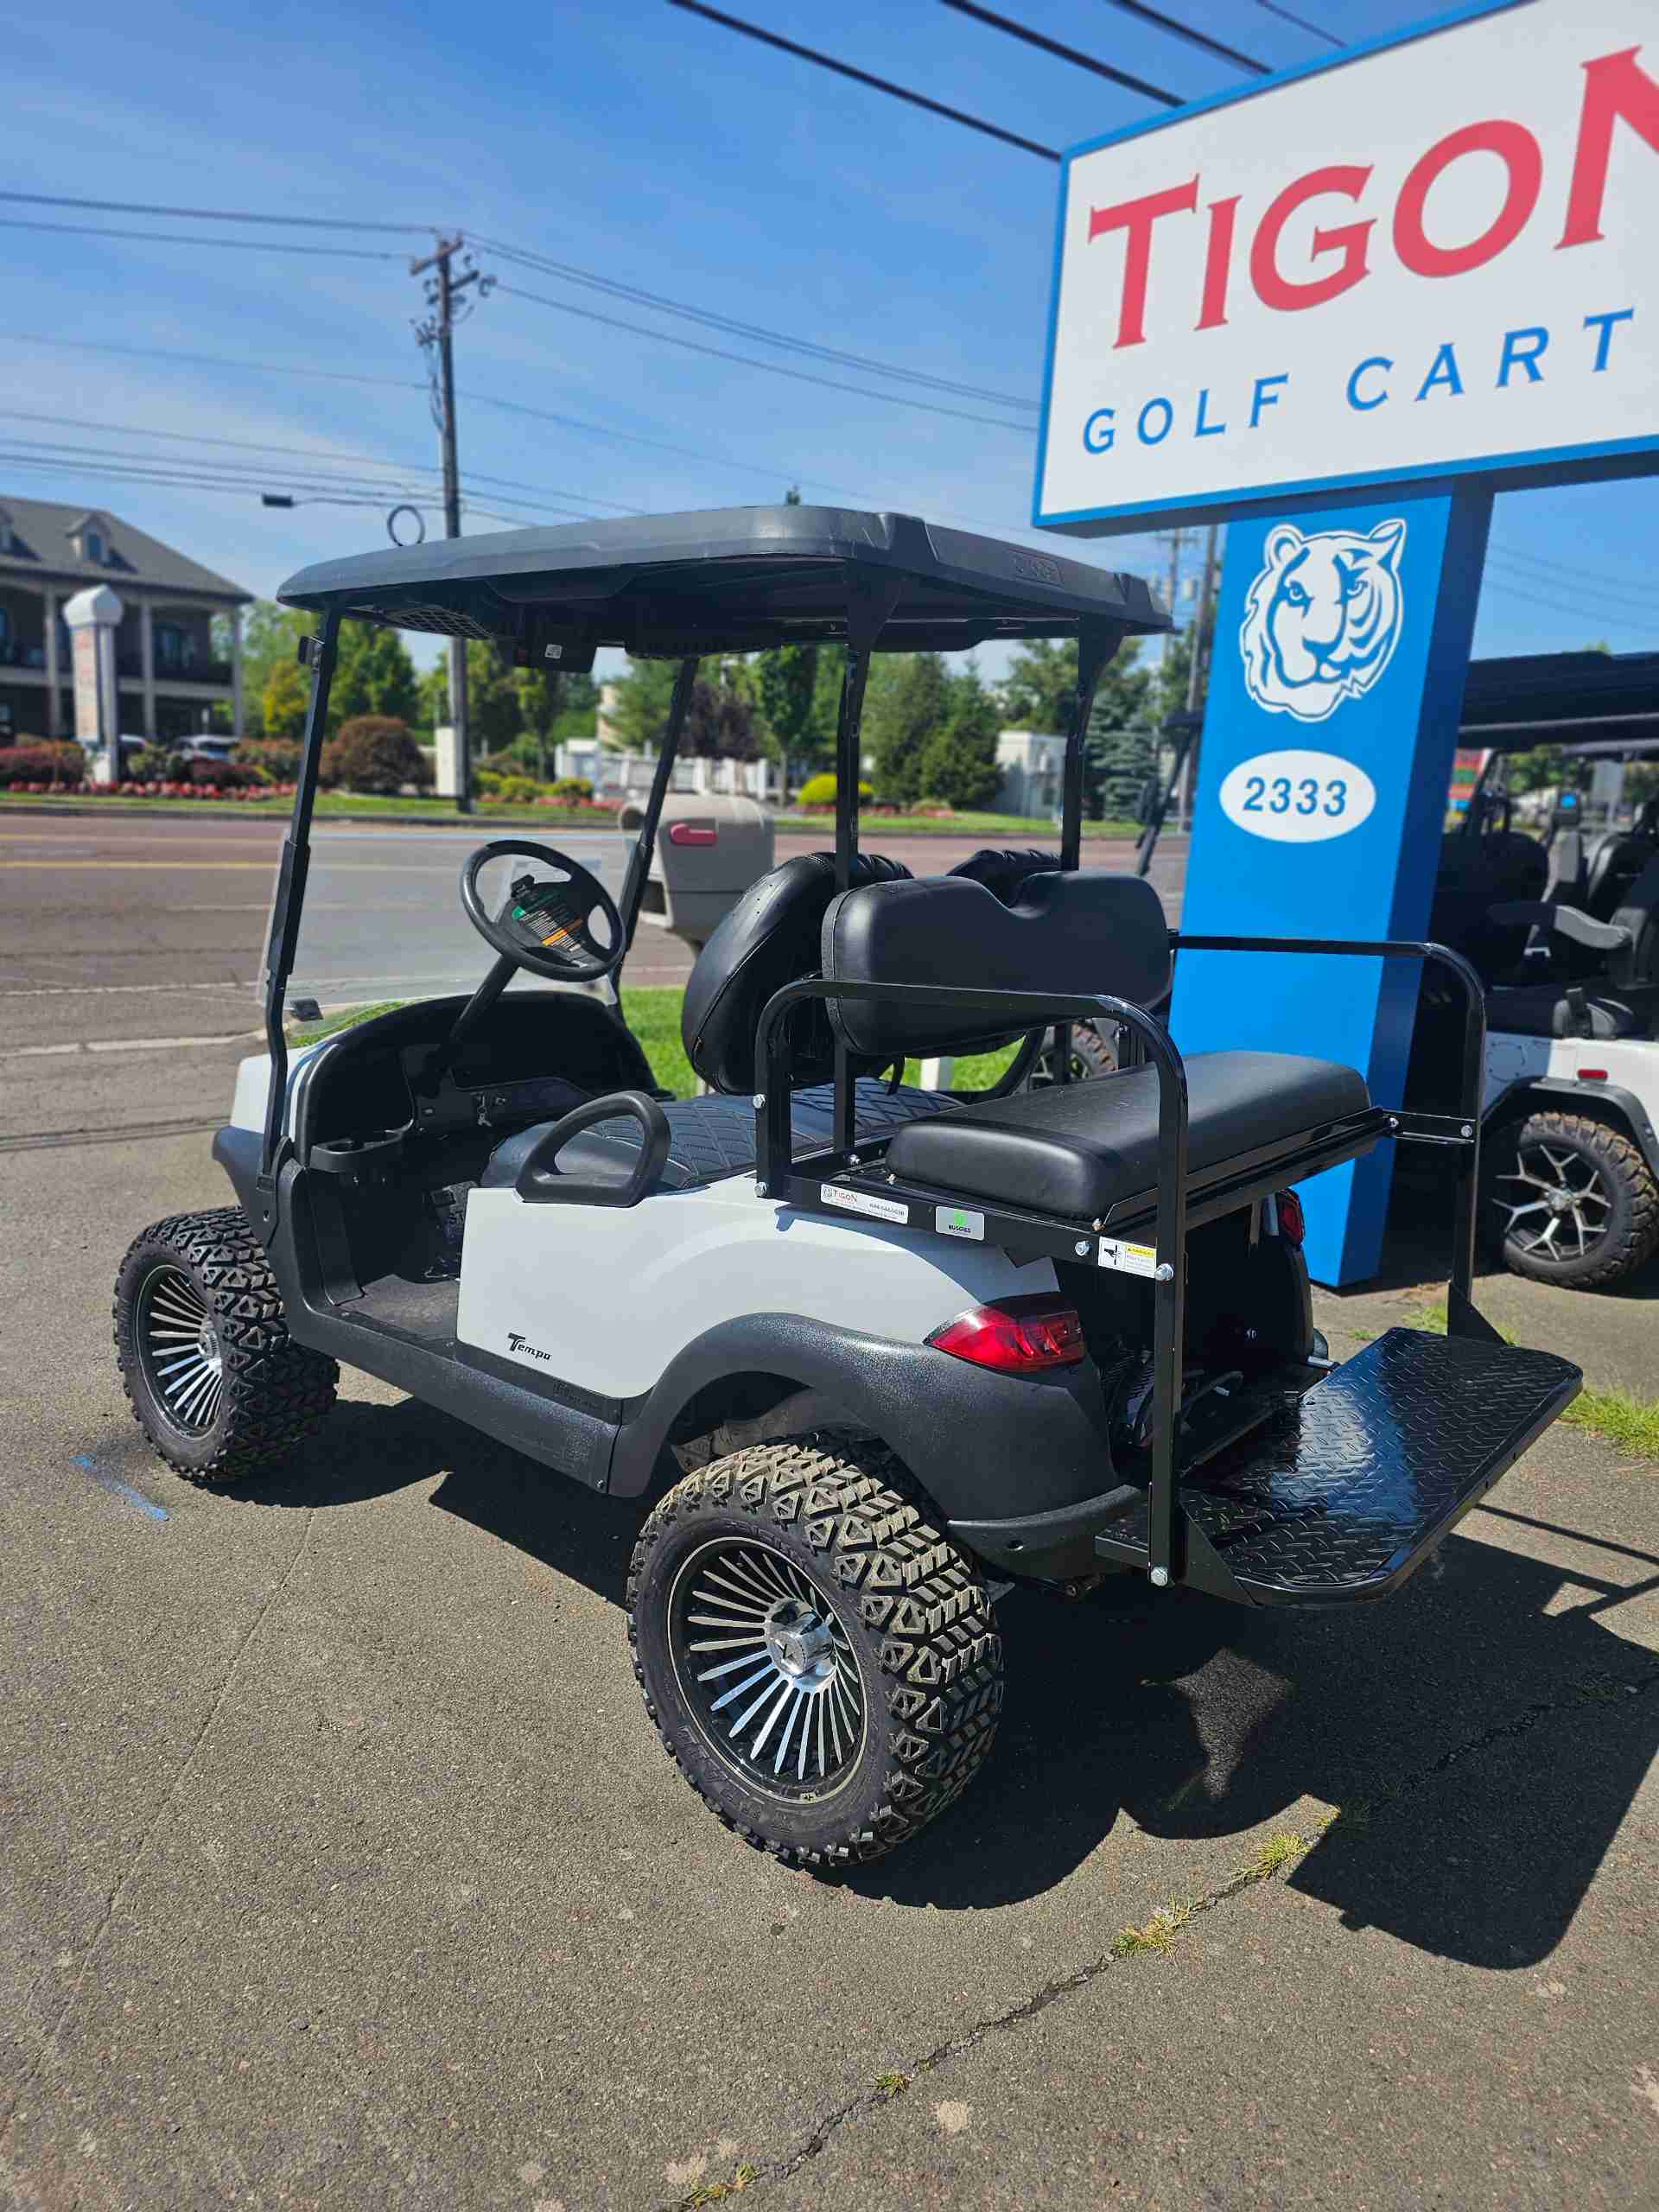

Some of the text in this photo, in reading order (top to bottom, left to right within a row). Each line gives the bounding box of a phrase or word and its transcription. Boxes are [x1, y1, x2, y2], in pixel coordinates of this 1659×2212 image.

[1082, 307, 1634, 455] GOLF CART
[1243, 776, 1347, 817] 2333
[508, 1332, 551, 1360] Tempo
